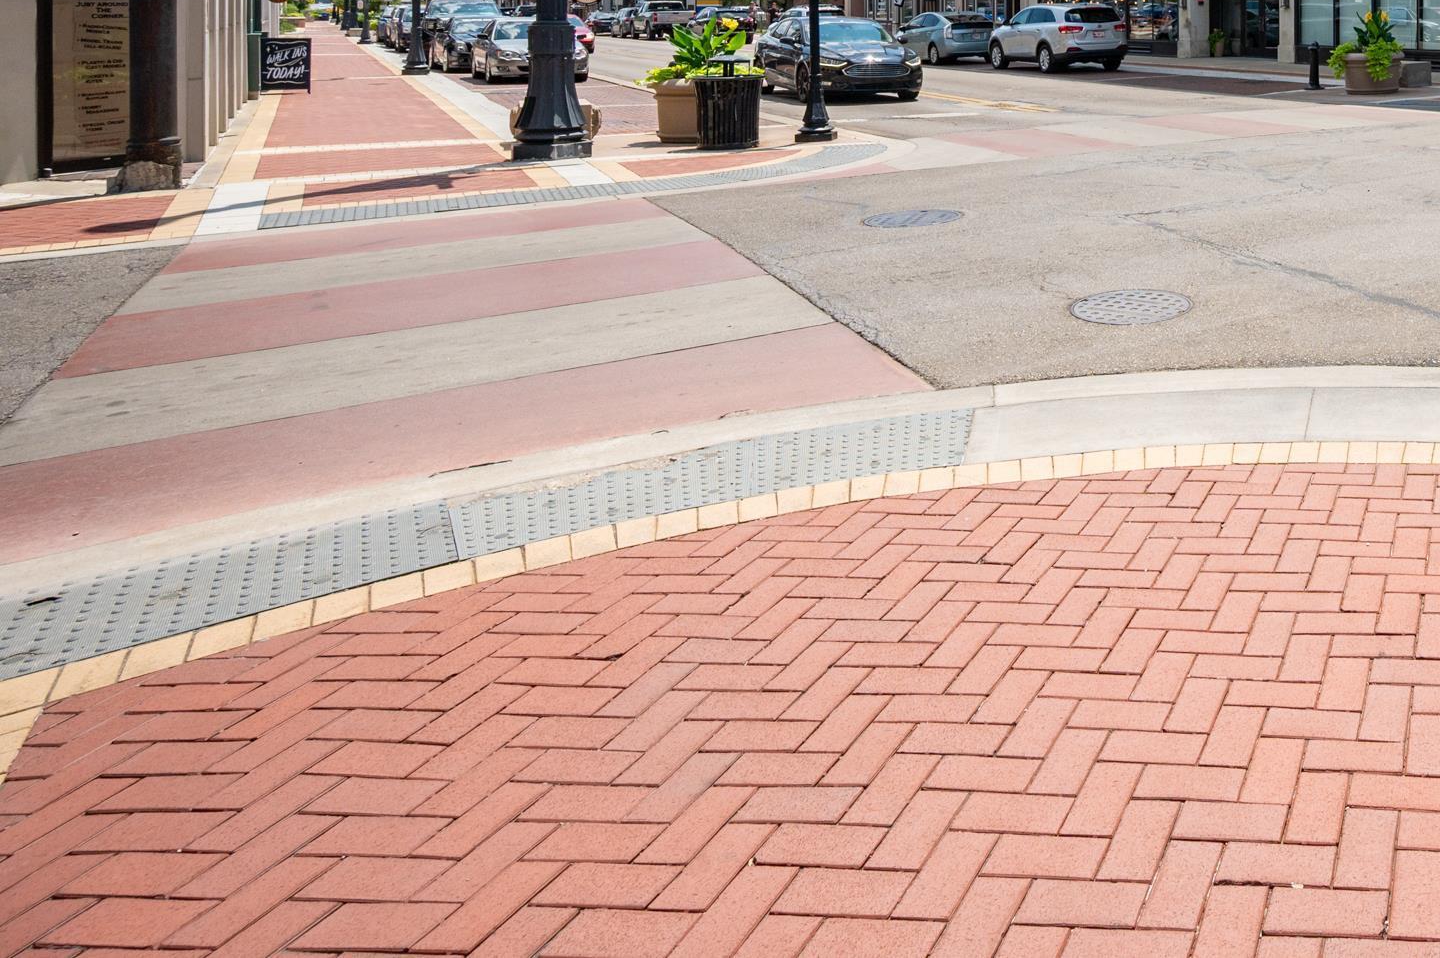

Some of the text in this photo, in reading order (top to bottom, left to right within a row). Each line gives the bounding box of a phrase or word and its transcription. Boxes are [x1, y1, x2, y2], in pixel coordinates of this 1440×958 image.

[267, 46, 308, 64] WALK INS
[266, 65, 305, 79] TODAY!
